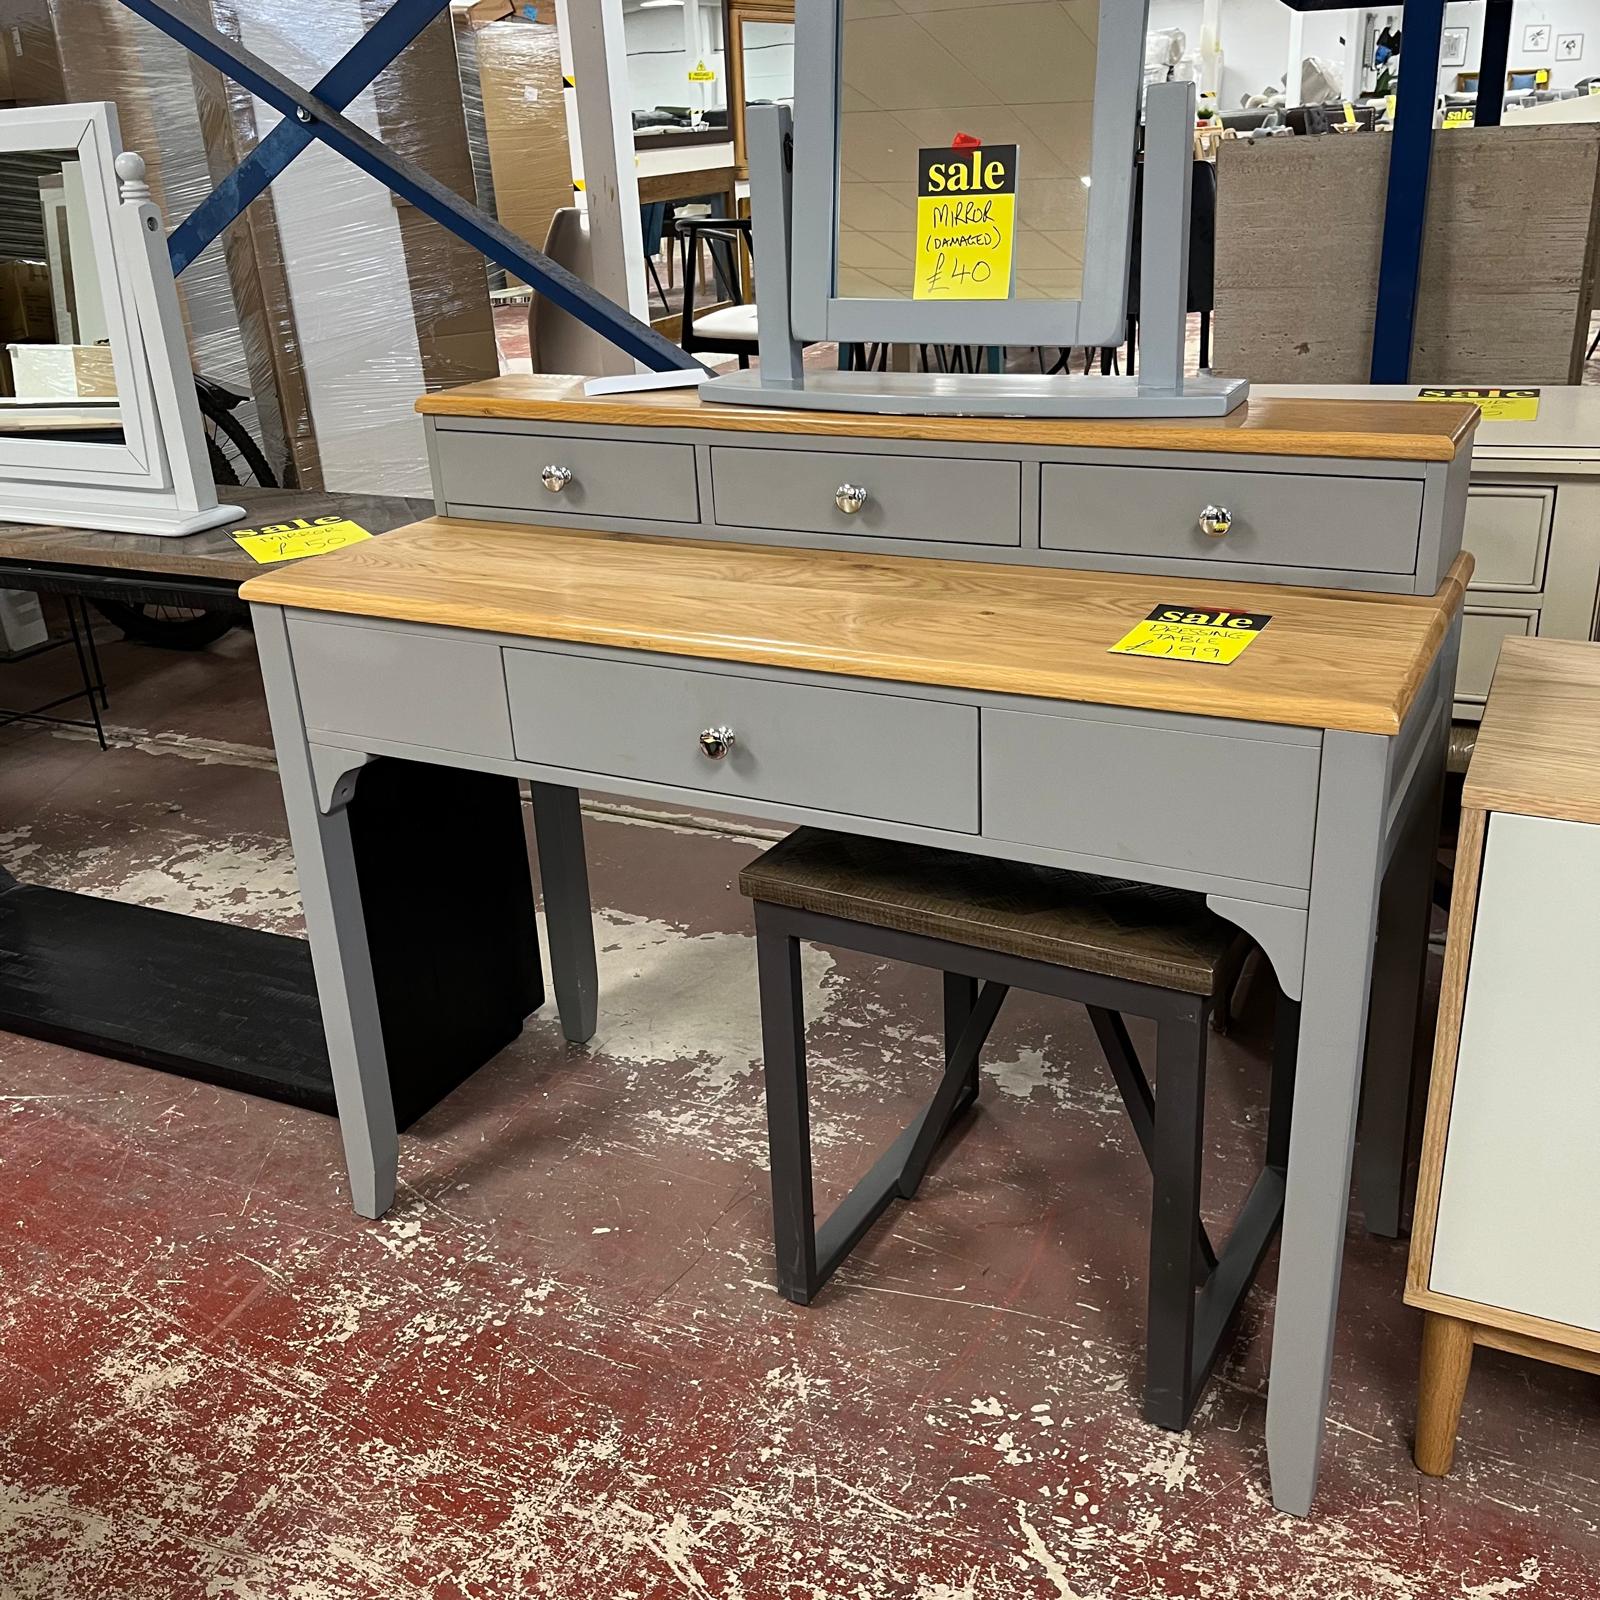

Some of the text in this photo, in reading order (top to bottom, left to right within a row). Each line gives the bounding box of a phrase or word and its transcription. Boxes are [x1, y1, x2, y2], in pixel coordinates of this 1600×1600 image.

[1447, 108, 1474, 120] sale
[928, 151, 1005, 192] sale
[933, 200, 995, 228] MIRROR
[926, 226, 1001, 252] (DAMAGED)
[926, 252, 991, 293] £40
[1423, 390, 1535, 398] sale
[232, 516, 342, 538] sale
[1158, 610, 1253, 629] sale
[1150, 623, 1247, 640] DRESSING
[1154, 633, 1220, 645] TABLE
[1125, 639, 1220, 658] £199
